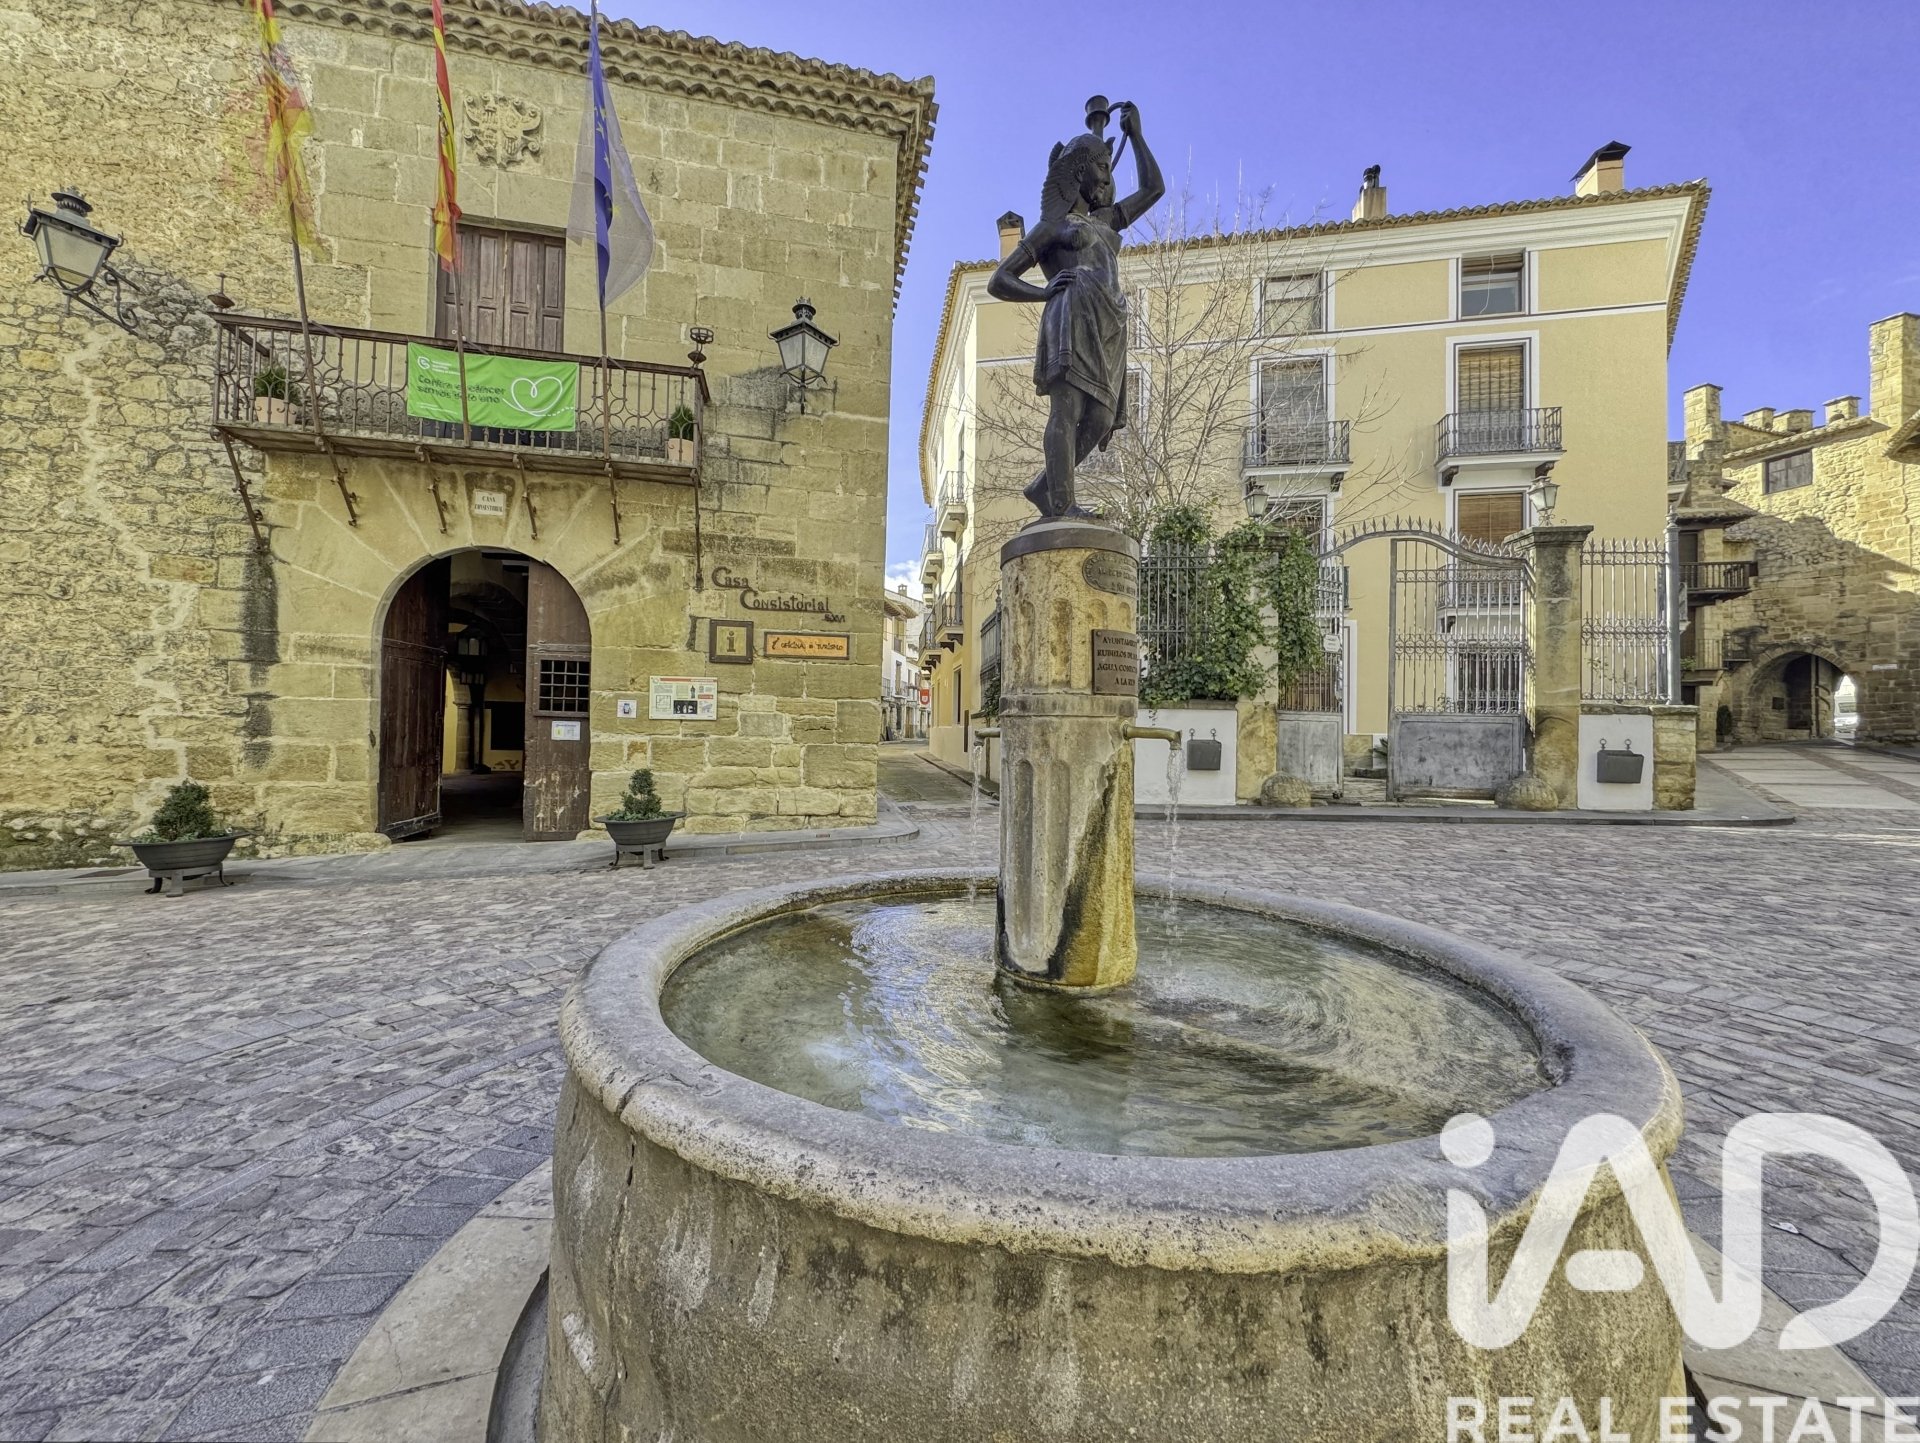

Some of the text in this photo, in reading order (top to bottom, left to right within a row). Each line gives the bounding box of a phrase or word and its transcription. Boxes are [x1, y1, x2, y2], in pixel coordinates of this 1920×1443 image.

[711, 566, 750, 589] Casa
[740, 589, 831, 613] Consistorial
[1097, 663, 1118, 672] AGUA
